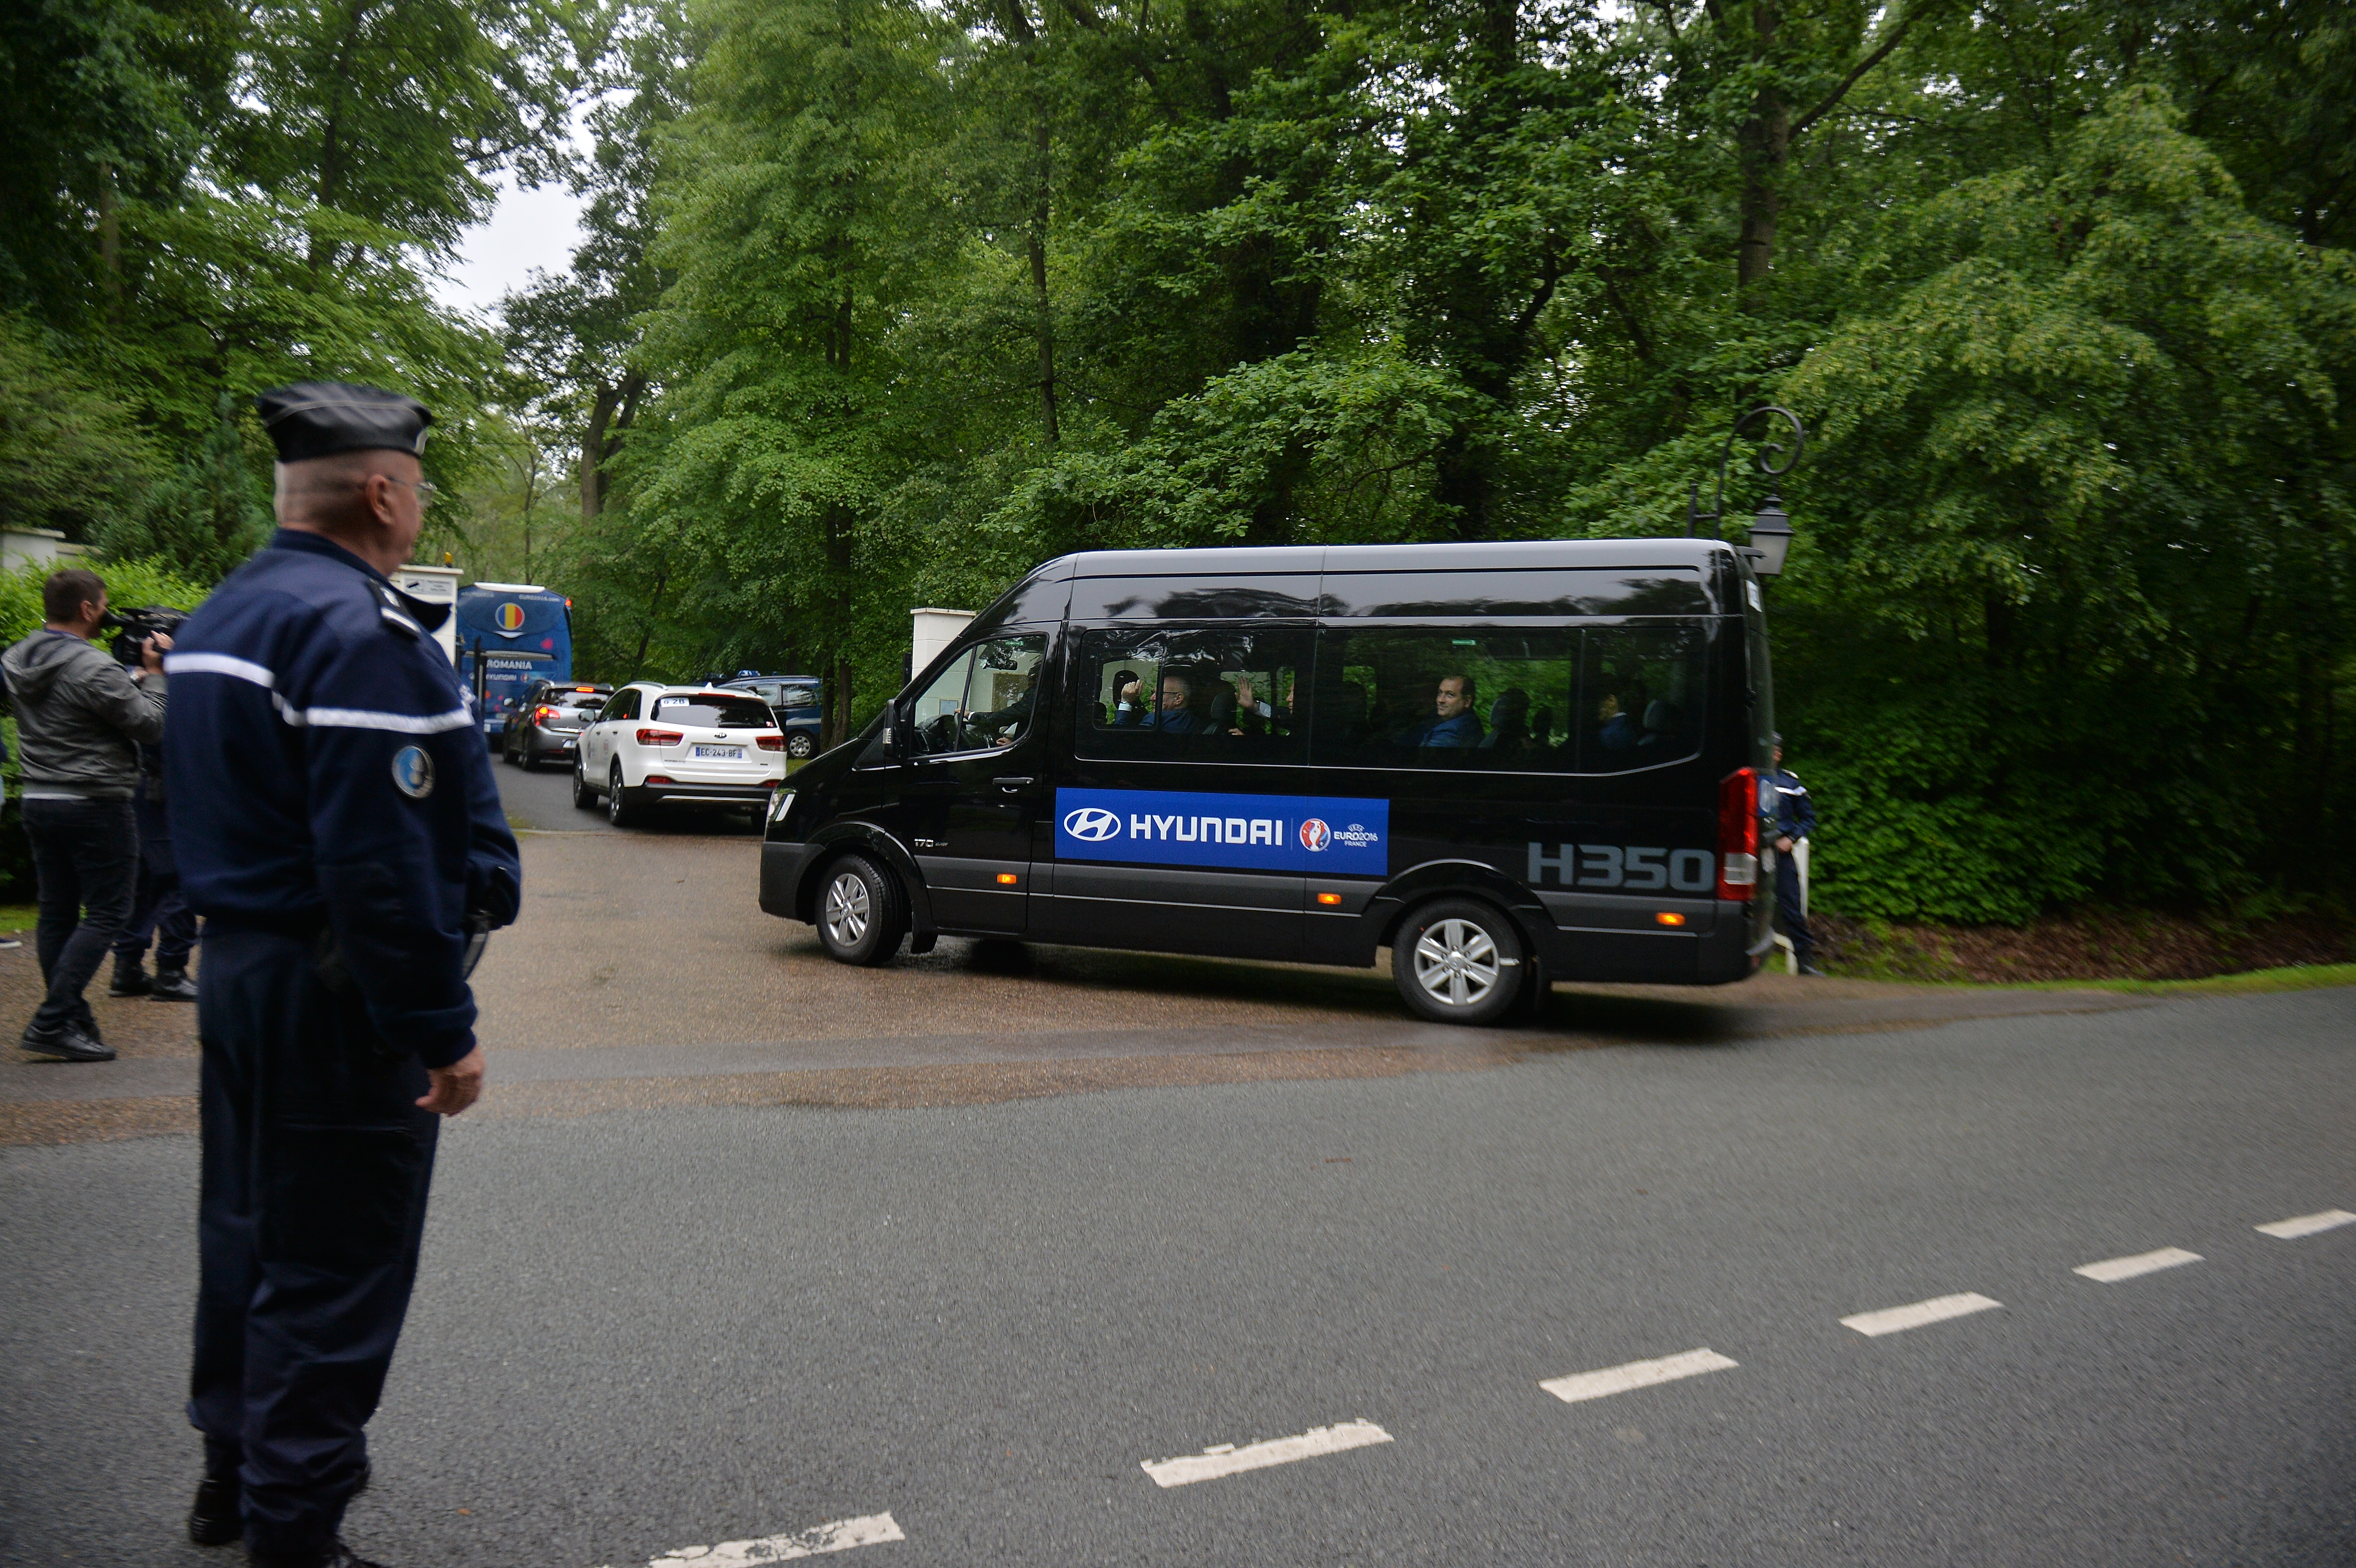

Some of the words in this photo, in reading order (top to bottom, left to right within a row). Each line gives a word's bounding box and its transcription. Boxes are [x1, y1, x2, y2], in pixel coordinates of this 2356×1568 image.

[486, 659, 532, 670] ROMANIA
[1130, 814, 1283, 846] HYUNDAI
[1333, 831, 1378, 842] EURO2016
[1528, 842, 1715, 892] H350
